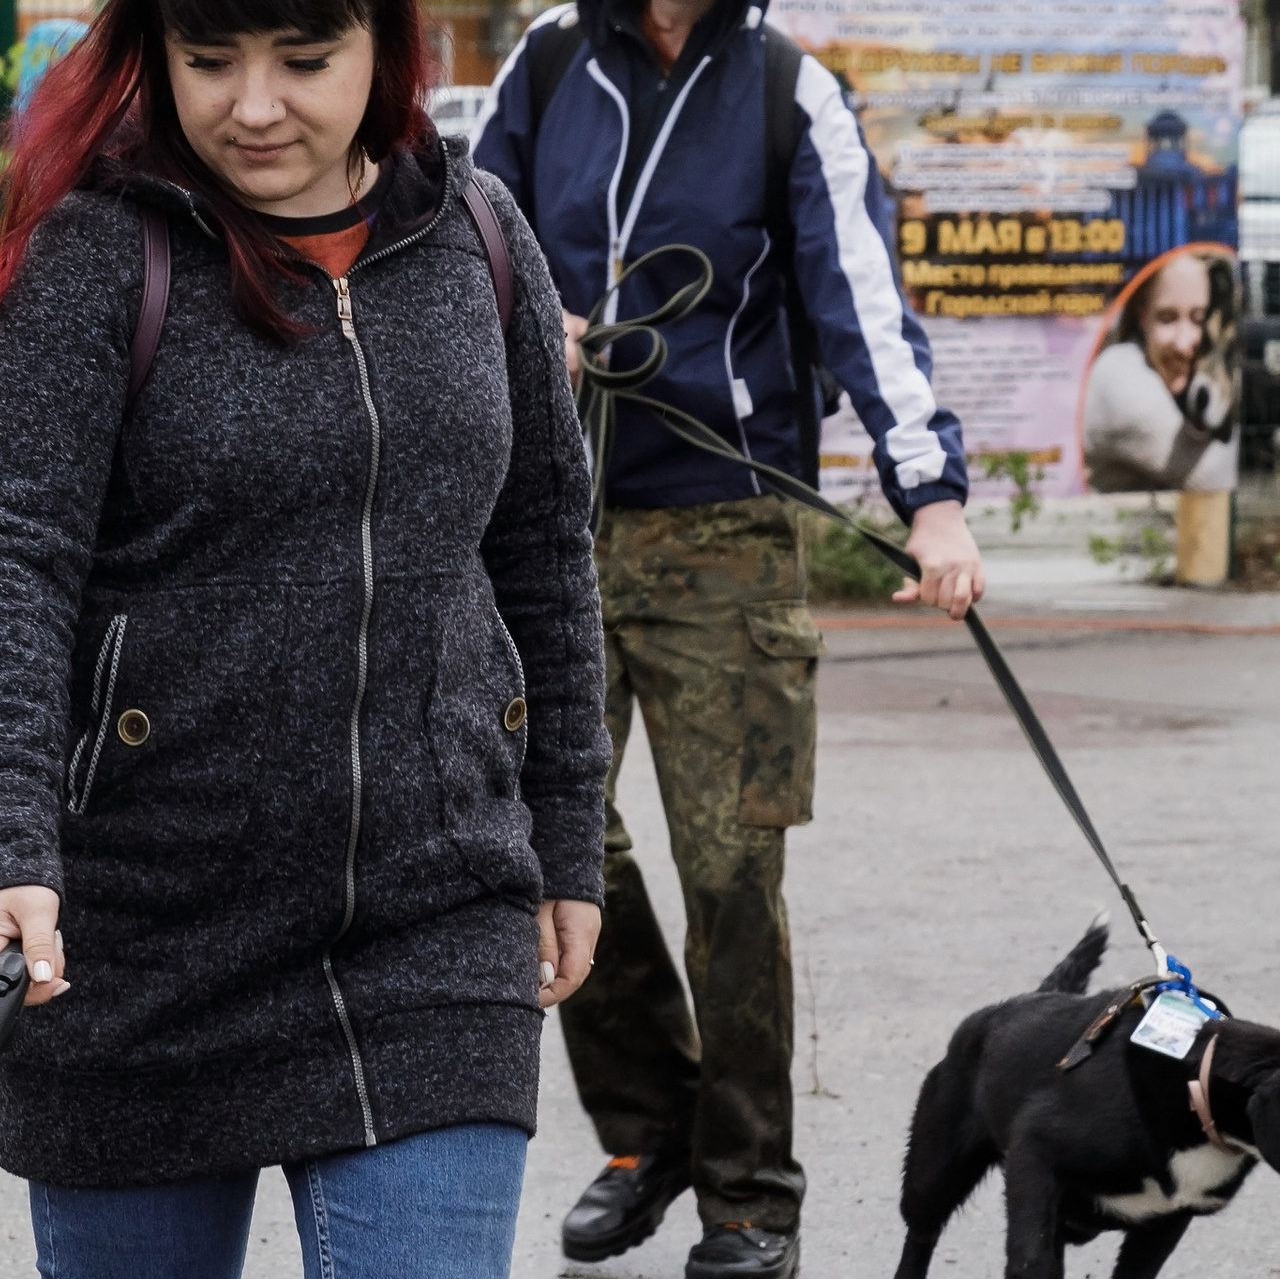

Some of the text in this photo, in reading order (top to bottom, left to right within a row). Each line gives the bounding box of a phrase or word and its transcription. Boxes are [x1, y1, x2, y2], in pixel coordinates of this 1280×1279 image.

[901, 221, 927, 254] 9
[937, 220, 1022, 254] МАЯ
[1051, 219, 1125, 252] 13:00
[902, 260, 986, 287] Место
[926, 290, 1051, 318] Городской
